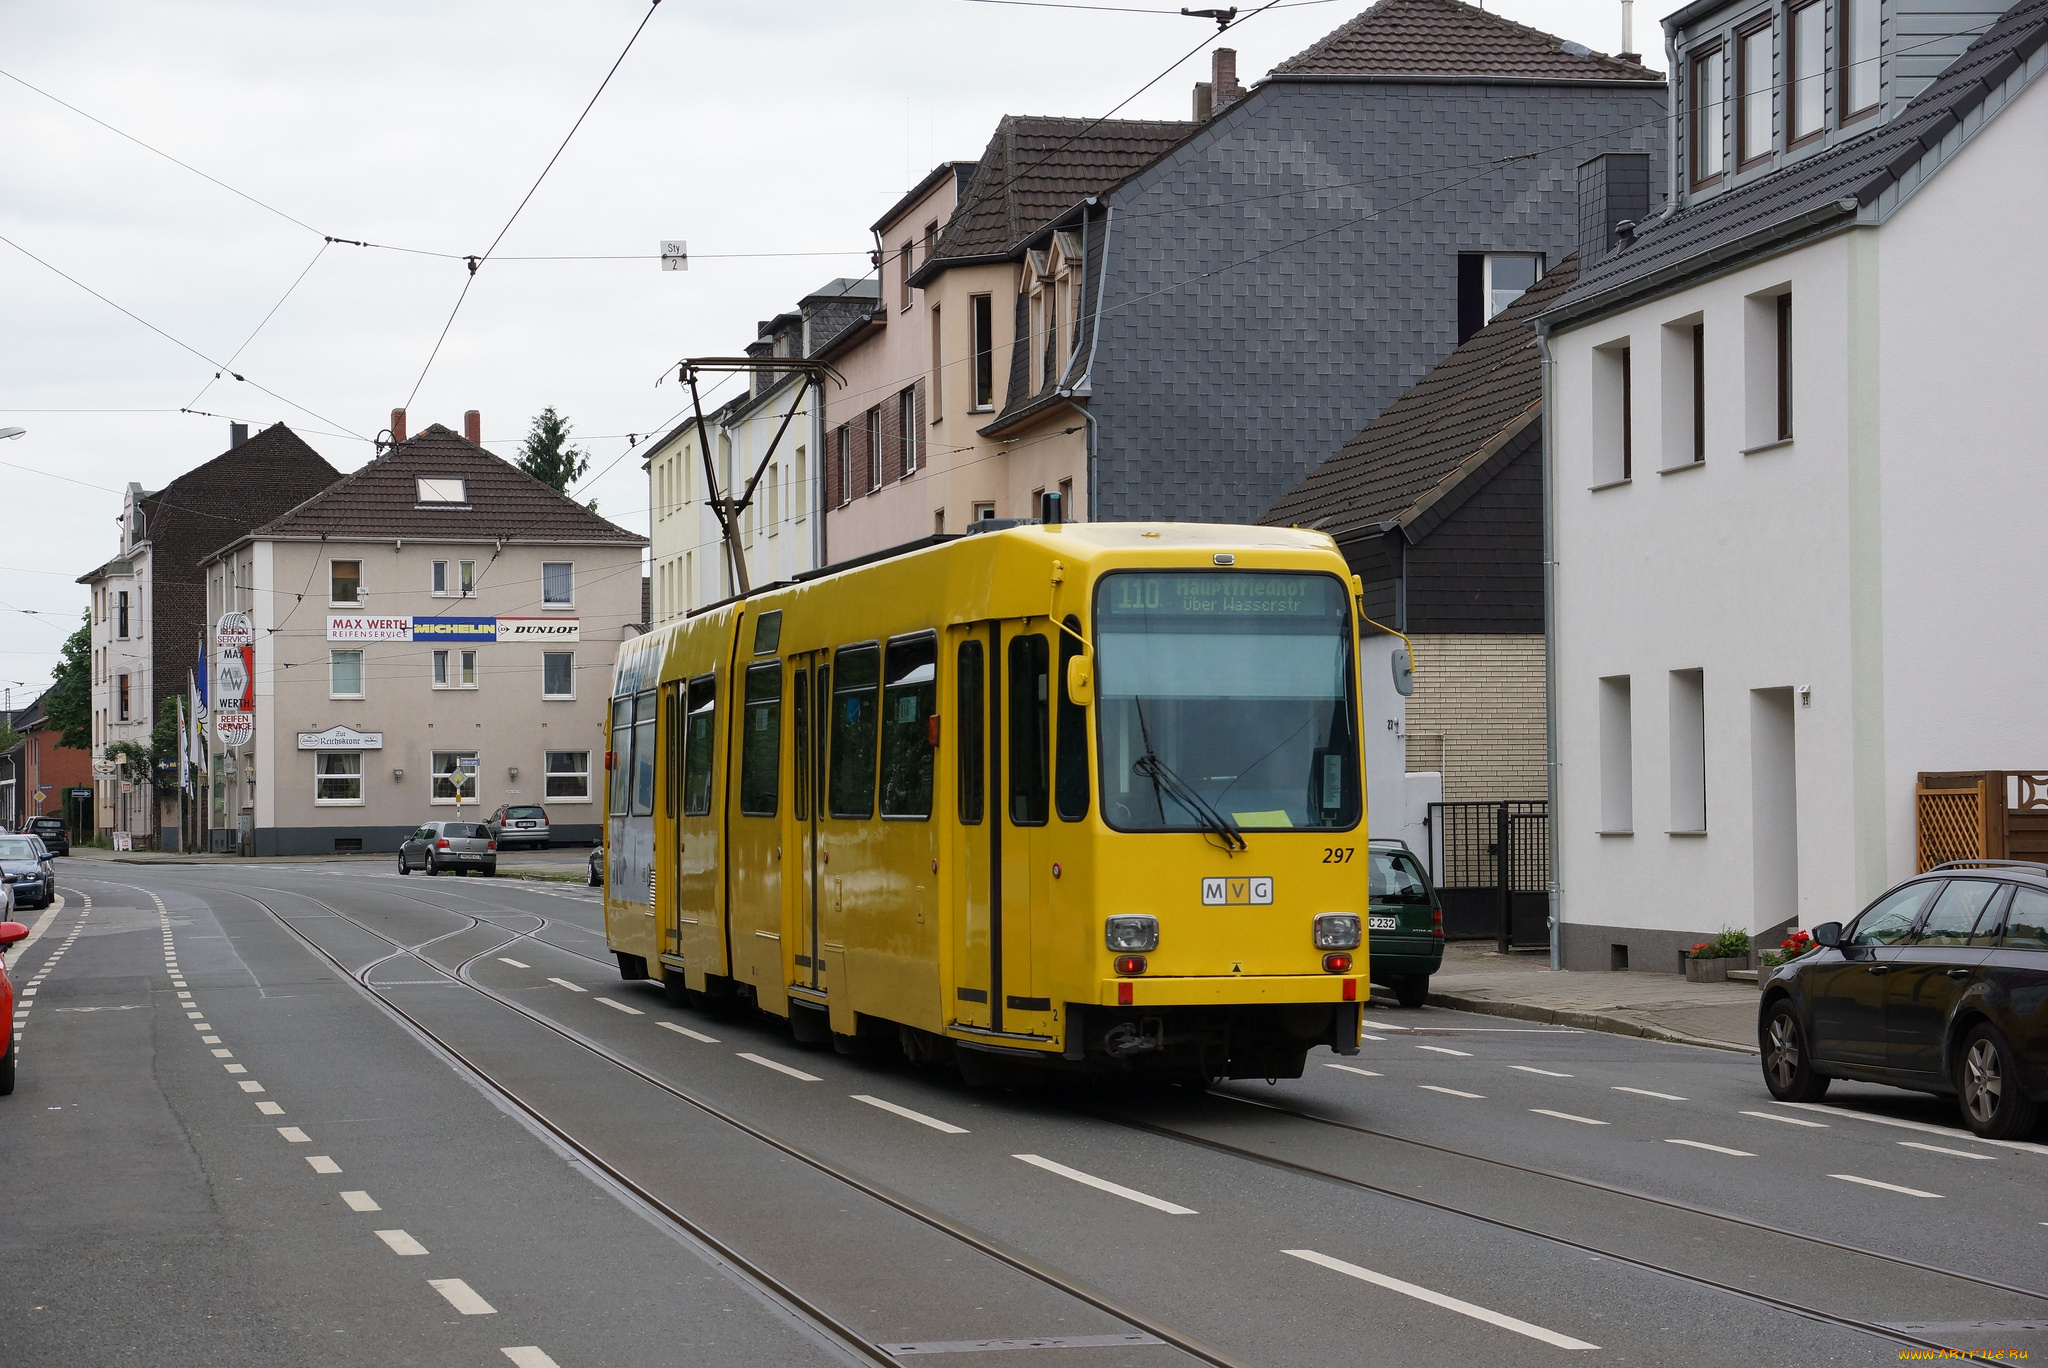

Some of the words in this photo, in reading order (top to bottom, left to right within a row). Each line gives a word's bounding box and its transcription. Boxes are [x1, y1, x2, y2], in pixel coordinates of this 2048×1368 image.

[668, 244, 680, 254] Sty
[672, 259, 678, 270] 2
[1118, 580, 1160, 608] 110
[1176, 578, 1306, 596] Hauptfriedhof
[1224, 596, 1300, 611] Wasserstr
[332, 619, 362, 629] MAX
[366, 619, 408, 629] WERTH
[414, 624, 495, 634] MICHELIN
[224, 650, 244, 658] MAX
[220, 698, 250, 708] WERTH
[218, 722, 252, 730] SERVICE
[320, 737, 360, 745] Reichskrone
[1322, 848, 1354, 864] 297
[1377, 918, 1394, 928] 232
[1053, 1008, 1058, 1021] 2
